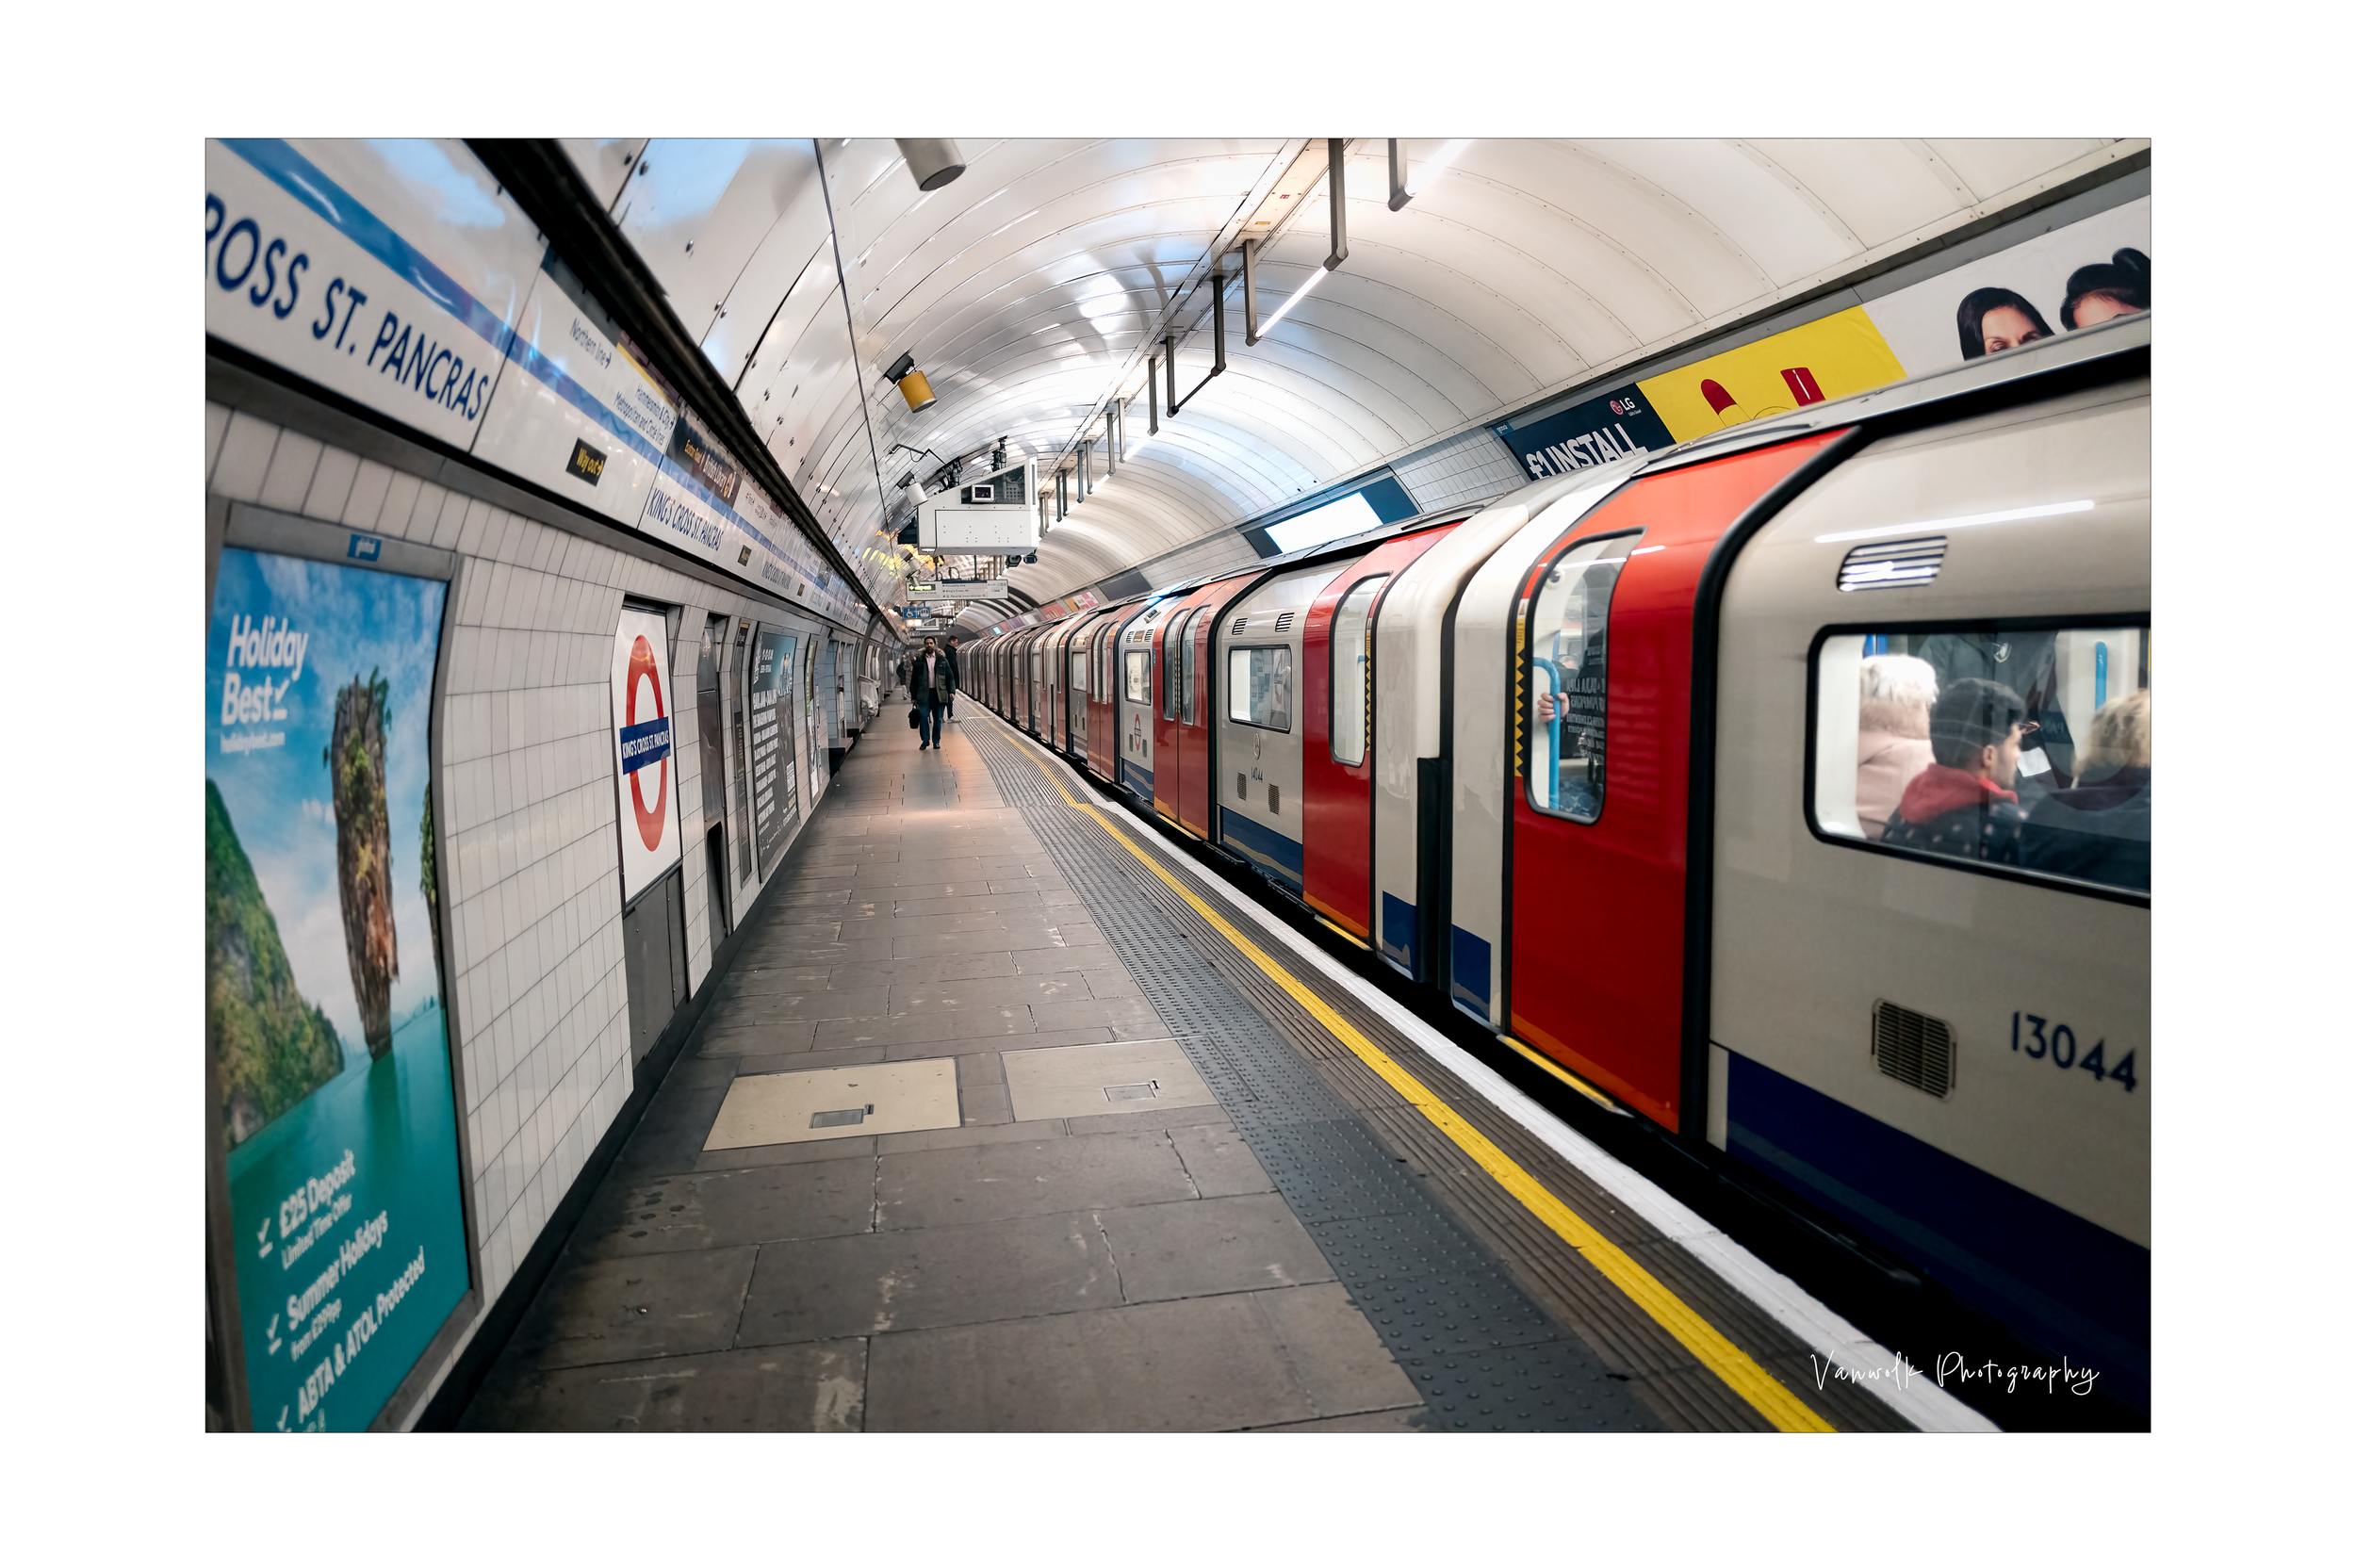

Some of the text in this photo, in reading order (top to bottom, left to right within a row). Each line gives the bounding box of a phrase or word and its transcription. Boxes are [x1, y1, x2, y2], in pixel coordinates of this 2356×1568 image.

[312, 277, 368, 355] ST.
[367, 311, 489, 421] PANCRAS
[570, 317, 597, 356] Northern
[1619, 397, 1636, 411] LG
[577, 447, 599, 475] Way out
[1526, 422, 1649, 480] £1 INSTALL
[646, 487, 676, 525] KING'S
[672, 503, 695, 535] CROSS
[698, 520, 724, 551] PANCRAS
[227, 613, 309, 681] Holiday
[221, 673, 273, 726] Best
[622, 739, 637, 760] KING'S
[636, 735, 649, 755] CROSS
[654, 729, 669, 748] PANCRAS
[2011, 1010, 2137, 1093] 13044
[279, 1148, 356, 1241] £25 Deposit
[281, 1225, 315, 1270] Limited
[312, 1212, 333, 1240] Time
[286, 1209, 388, 1332] Summer Holidays
[298, 1356, 335, 1425] ABTA
[334, 1342, 347, 1378] &
[346, 1304, 378, 1364] ATOL
[376, 1244, 426, 1325] Protected
